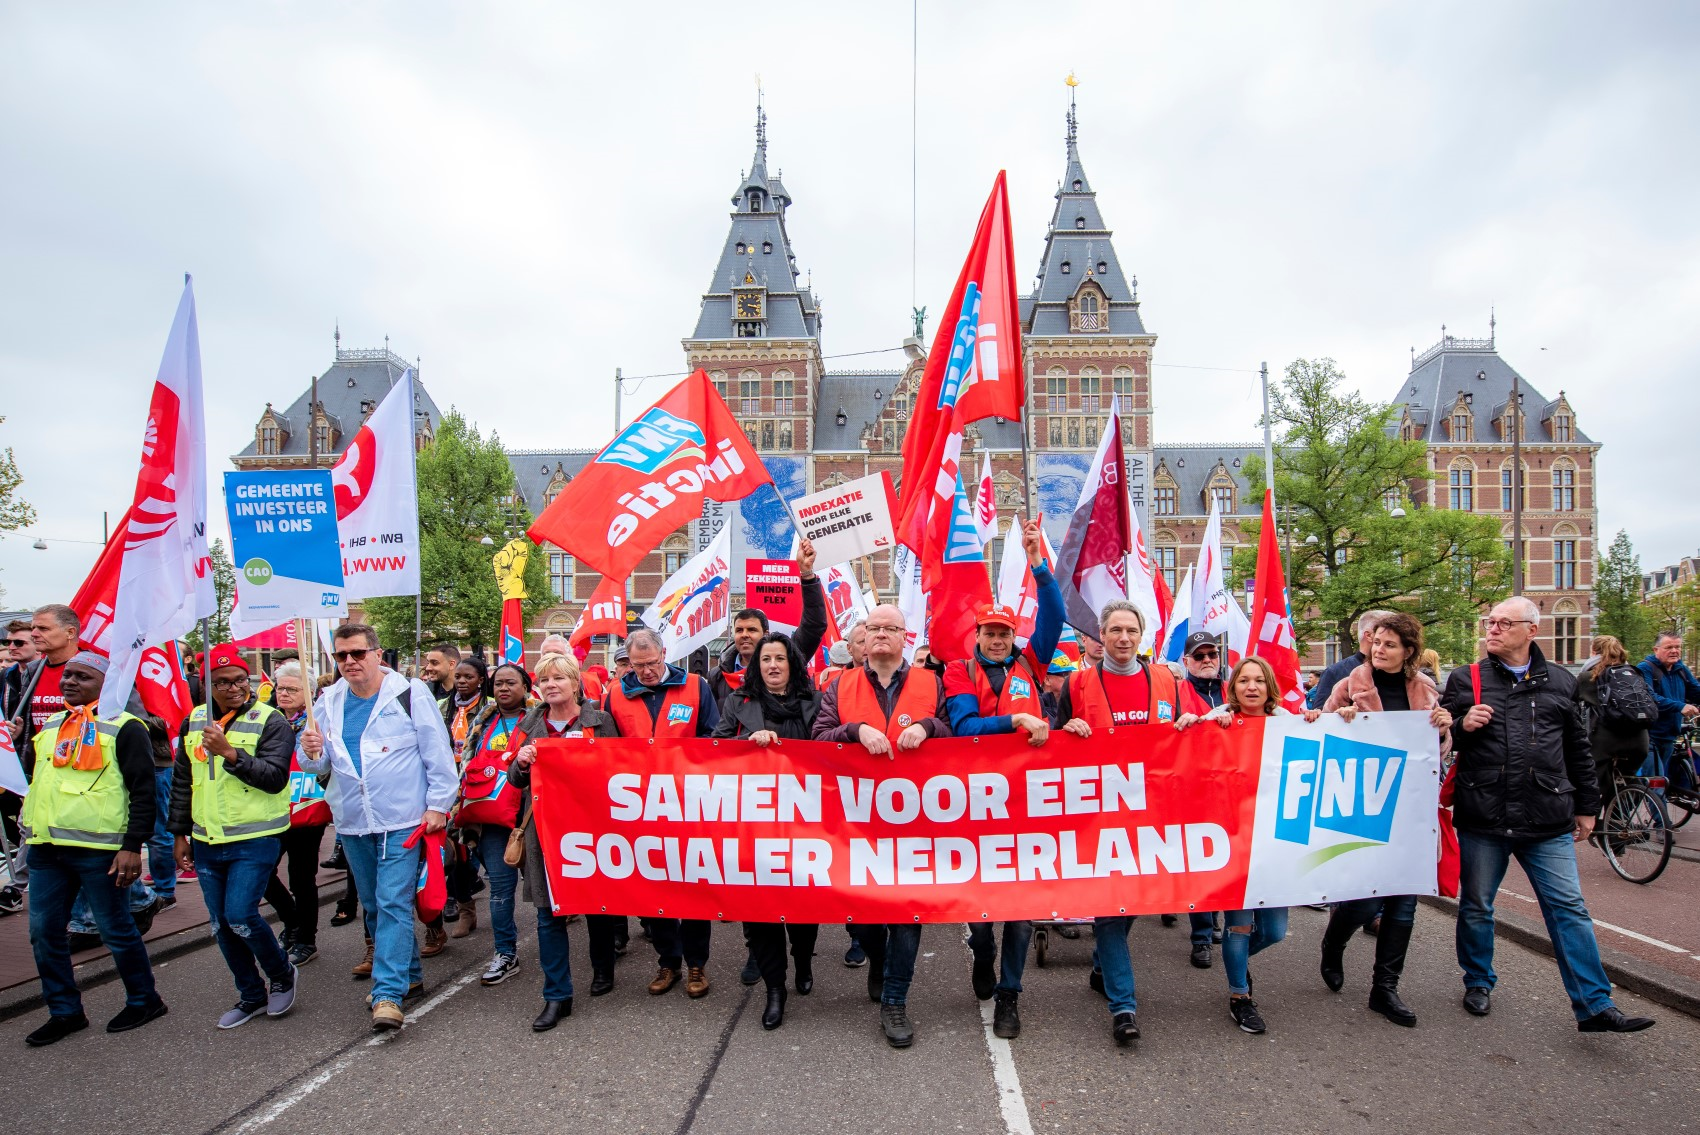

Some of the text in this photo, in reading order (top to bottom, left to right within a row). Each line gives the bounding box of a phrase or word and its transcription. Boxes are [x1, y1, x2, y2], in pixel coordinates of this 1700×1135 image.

[236, 483, 323, 499] GEMEENTE
[1133, 459, 1144, 507] ALL THE
[235, 501, 327, 516] INVESTEER
[799, 490, 863, 519] INDEXATIE
[255, 519, 313, 533] IN ONS
[699, 498, 710, 552] REMBRA
[802, 507, 851, 528] VOOR ELKE
[807, 512, 873, 541] GENERATIE
[246, 567, 270, 577] CAO
[762, 564, 790, 574] MEER
[746, 574, 800, 584] ZEKERHEID
[756, 585, 794, 594] MINDER
[321, 593, 339, 605] FNV
[763, 595, 786, 604] FLEX
[286, 618, 297, 643] MO
[1011, 678, 1030, 695] FNV
[668, 704, 693, 718] FNV
[291, 776, 325, 796] FN
[608, 762, 1147, 825] SAMEN VOOR EEN
[1282, 757, 1402, 820] FNV
[560, 822, 1231, 887] SOCIALER NEDERLAND
